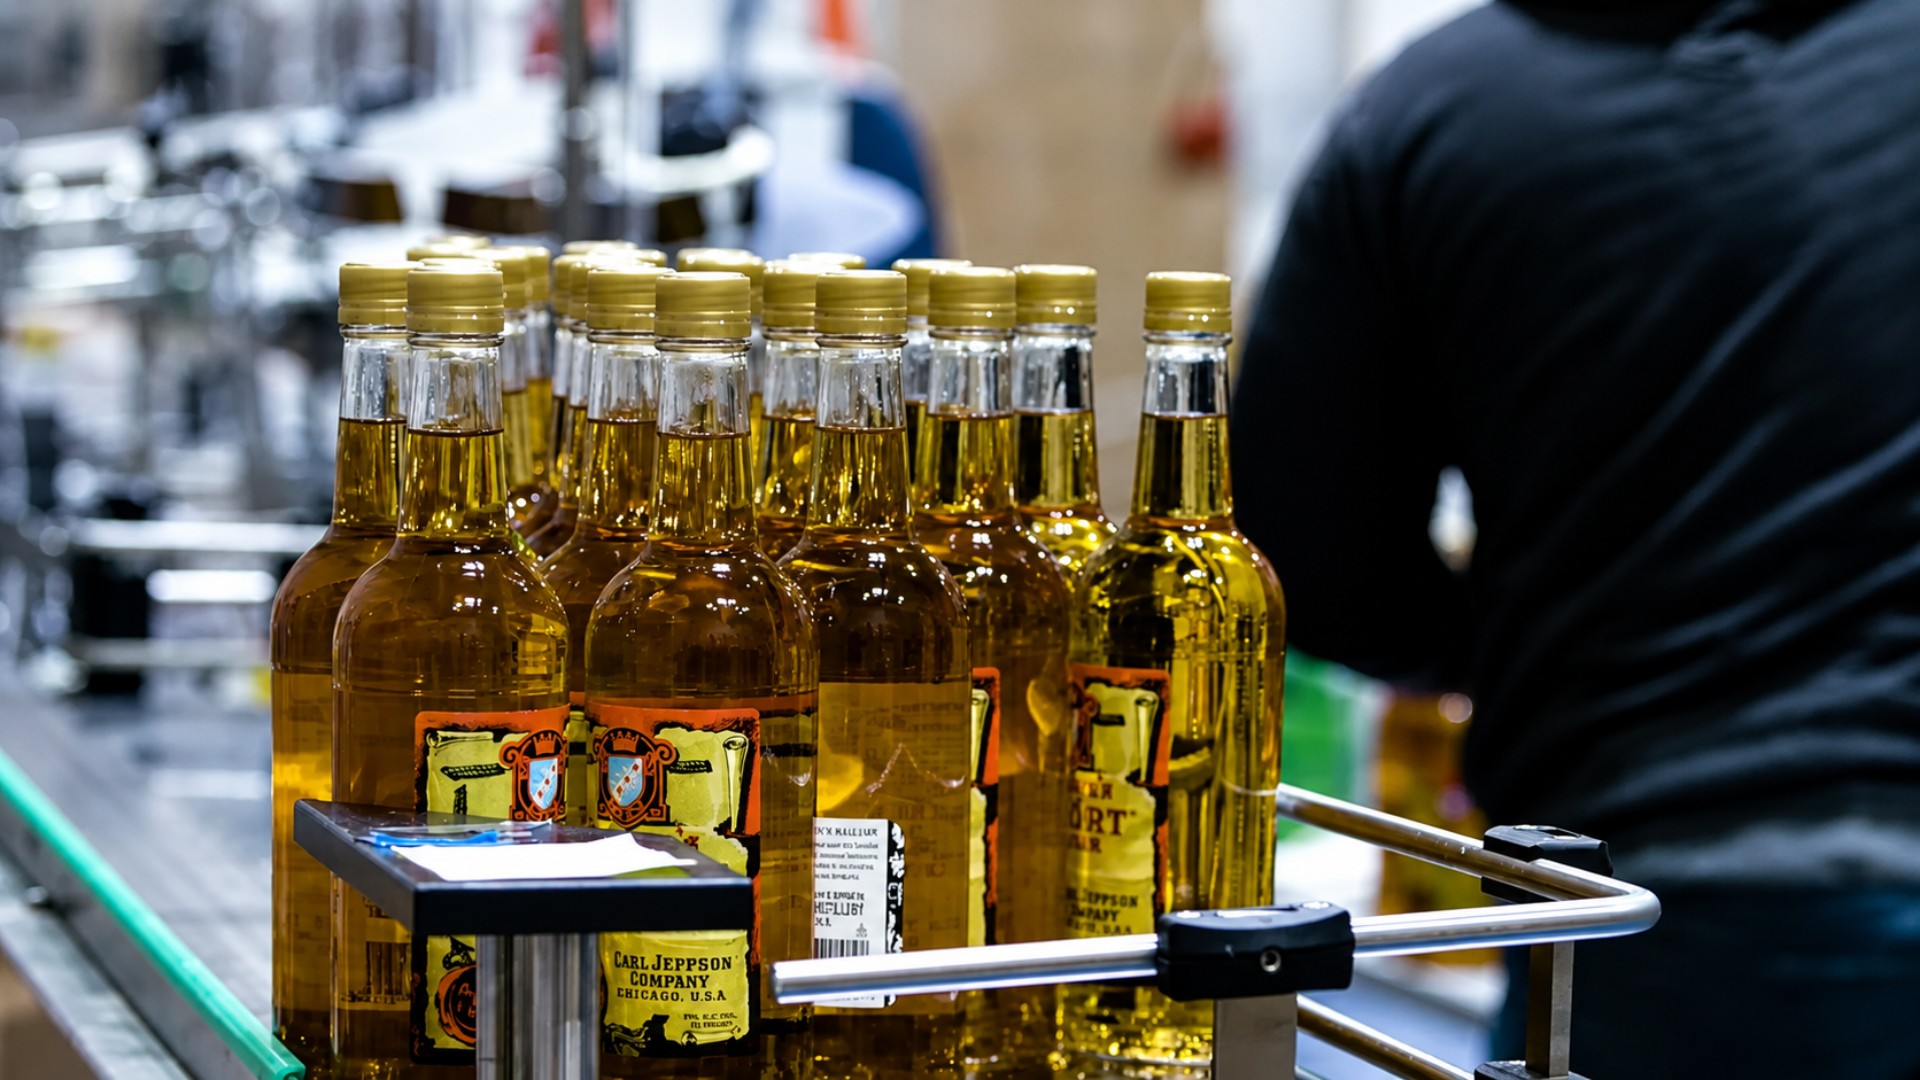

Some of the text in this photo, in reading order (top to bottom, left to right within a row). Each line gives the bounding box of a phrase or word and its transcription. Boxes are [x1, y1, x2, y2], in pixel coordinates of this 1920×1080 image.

[614, 950, 732, 971] CARL JEPPSON
[630, 971, 710, 988] COMPANY
[617, 987, 684, 1002] CHICAGO,
